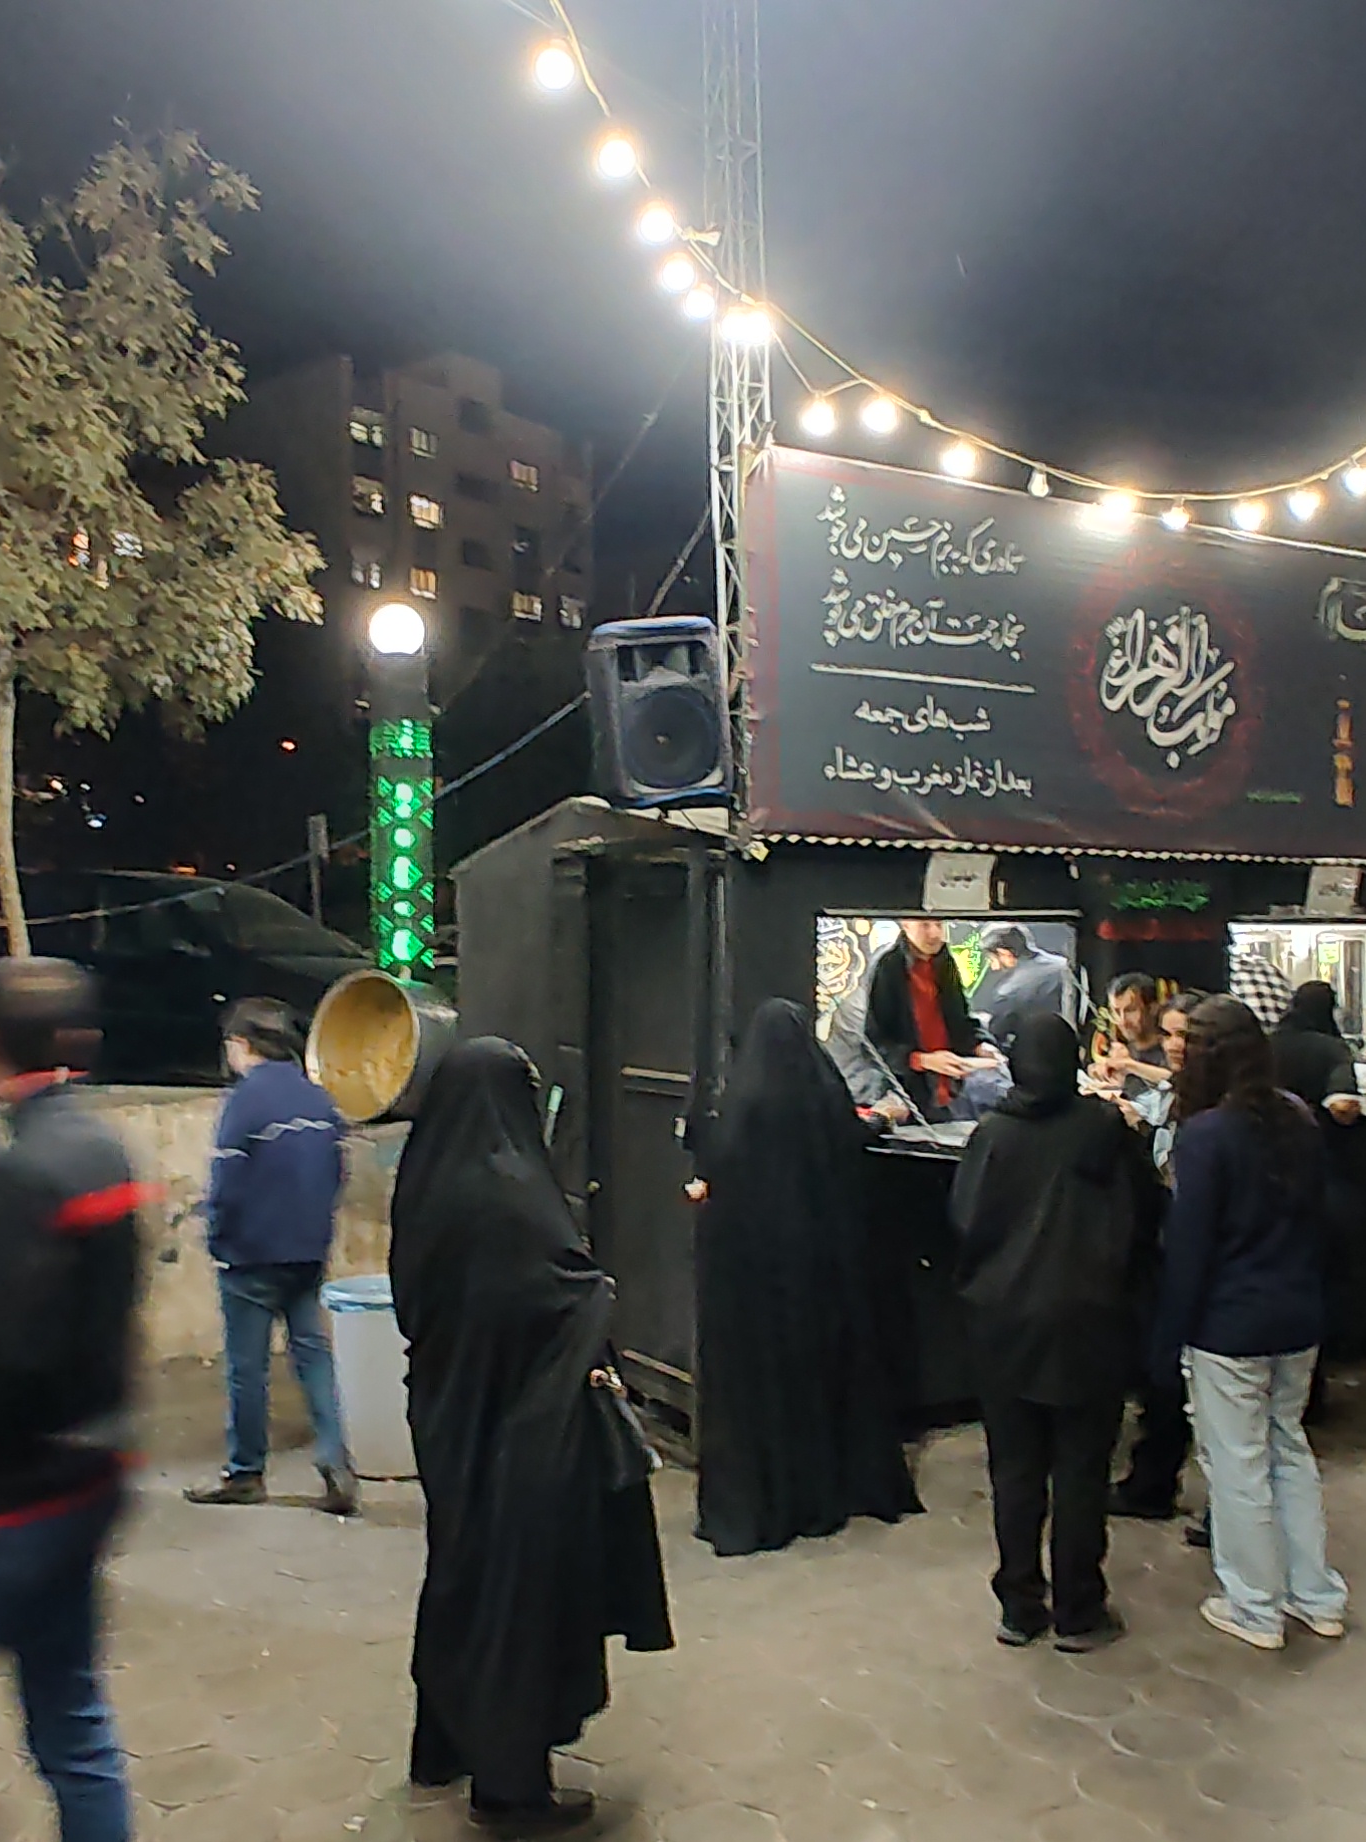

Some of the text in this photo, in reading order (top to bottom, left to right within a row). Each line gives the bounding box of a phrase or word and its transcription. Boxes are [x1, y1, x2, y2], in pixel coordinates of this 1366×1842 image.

[863, 516, 943, 571] حسین
[854, 700, 908, 735] جمعه
[873, 765, 893, 792] و
[892, 762, 953, 796] مغرب
[948, 755, 990, 796] نماز
[980, 758, 1008, 798] از
[1005, 769, 1033, 798] بعد
